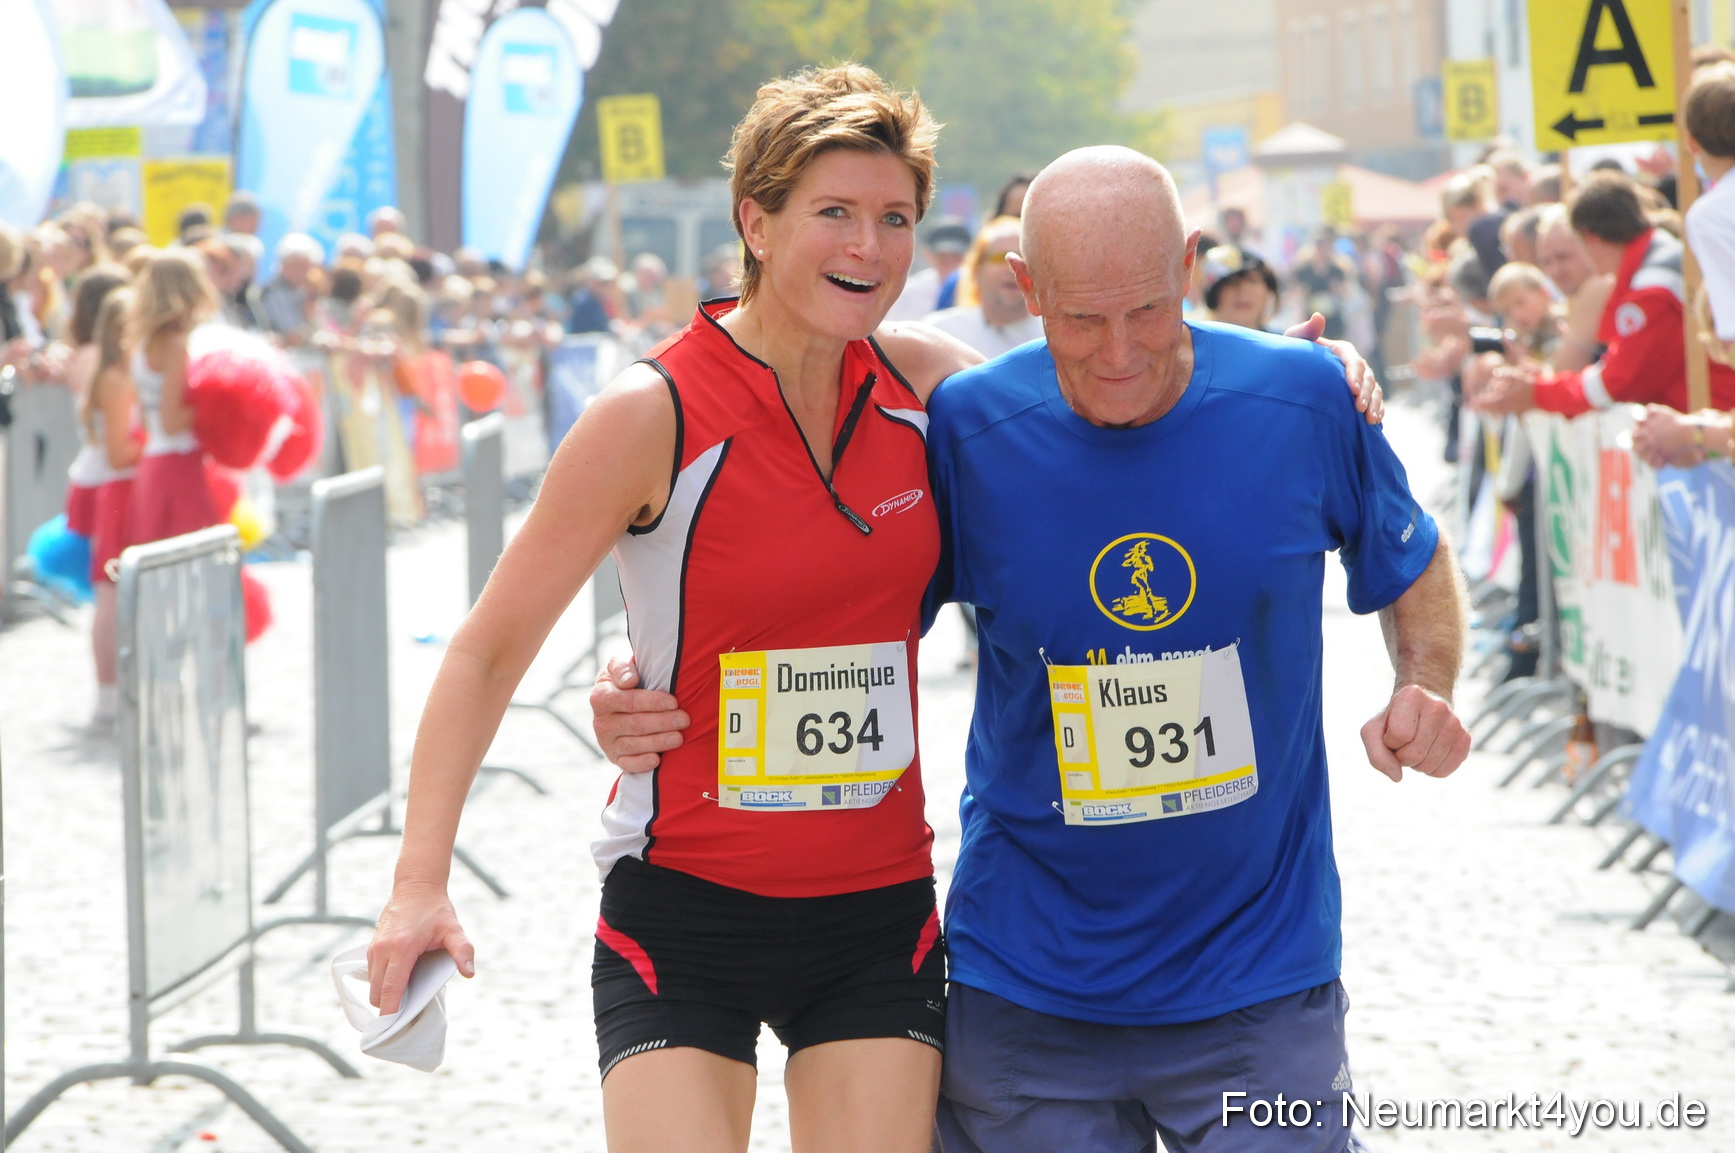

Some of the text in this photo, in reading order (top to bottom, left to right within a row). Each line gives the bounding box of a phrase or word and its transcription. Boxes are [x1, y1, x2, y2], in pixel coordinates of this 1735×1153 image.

[1566, 0, 1658, 93] A
[1459, 81, 1490, 123] B
[615, 123, 649, 164] B
[880, 491, 918, 517] DYNAMICS
[777, 662, 895, 694] Dominique
[1098, 678, 1168, 708] Klaus
[729, 712, 742, 734] D
[796, 708, 884, 756] 634
[1063, 726, 1074, 748] D
[1124, 715, 1216, 768] 931
[740, 790, 793, 802] BOCK
[1184, 775, 1255, 803] PFLEIDERER
[1082, 803, 1132, 816] BOCK
